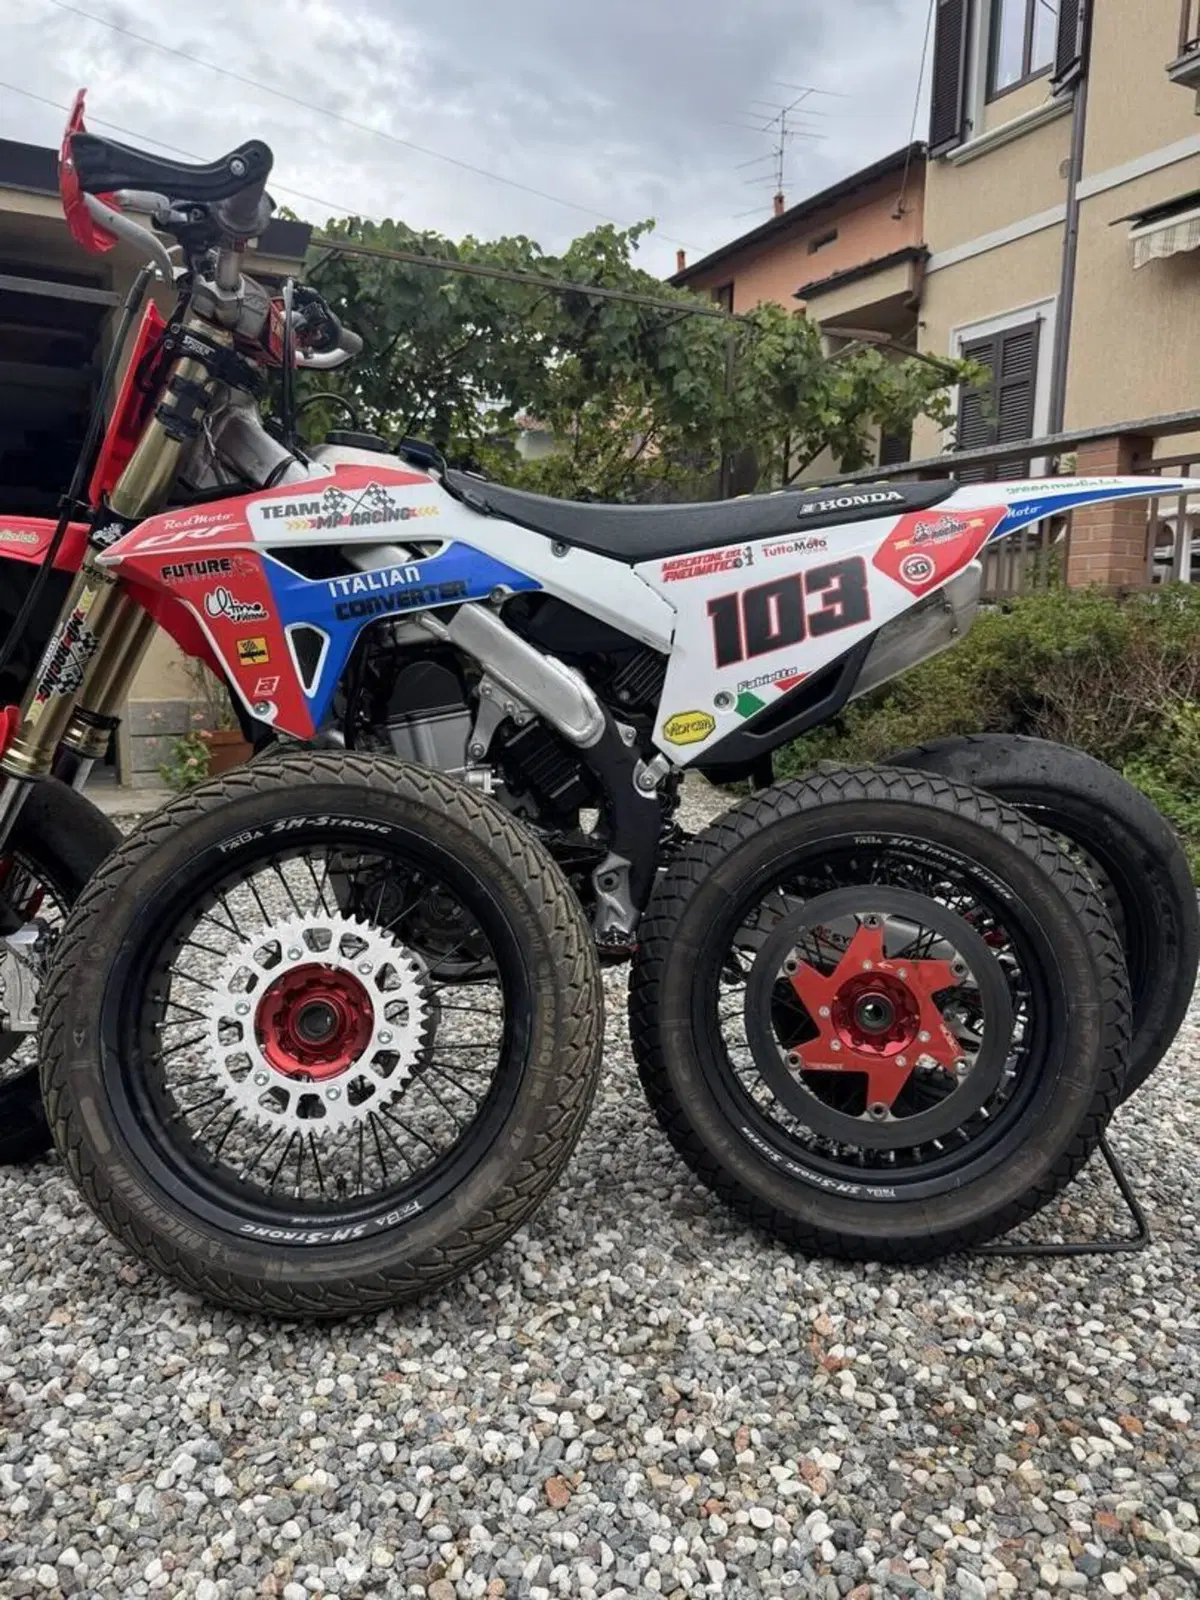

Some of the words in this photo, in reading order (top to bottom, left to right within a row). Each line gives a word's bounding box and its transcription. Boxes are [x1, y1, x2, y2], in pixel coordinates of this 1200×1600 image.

[260, 502, 321, 519] TEAM
[819, 491, 905, 511] HONDA
[164, 513, 235, 529] RedMoto
[316, 515, 344, 530] MP
[349, 507, 410, 526] RACING
[161, 558, 231, 579] FUTURE
[335, 580, 468, 620] CONVERTER
[707, 556, 871, 669] 103
